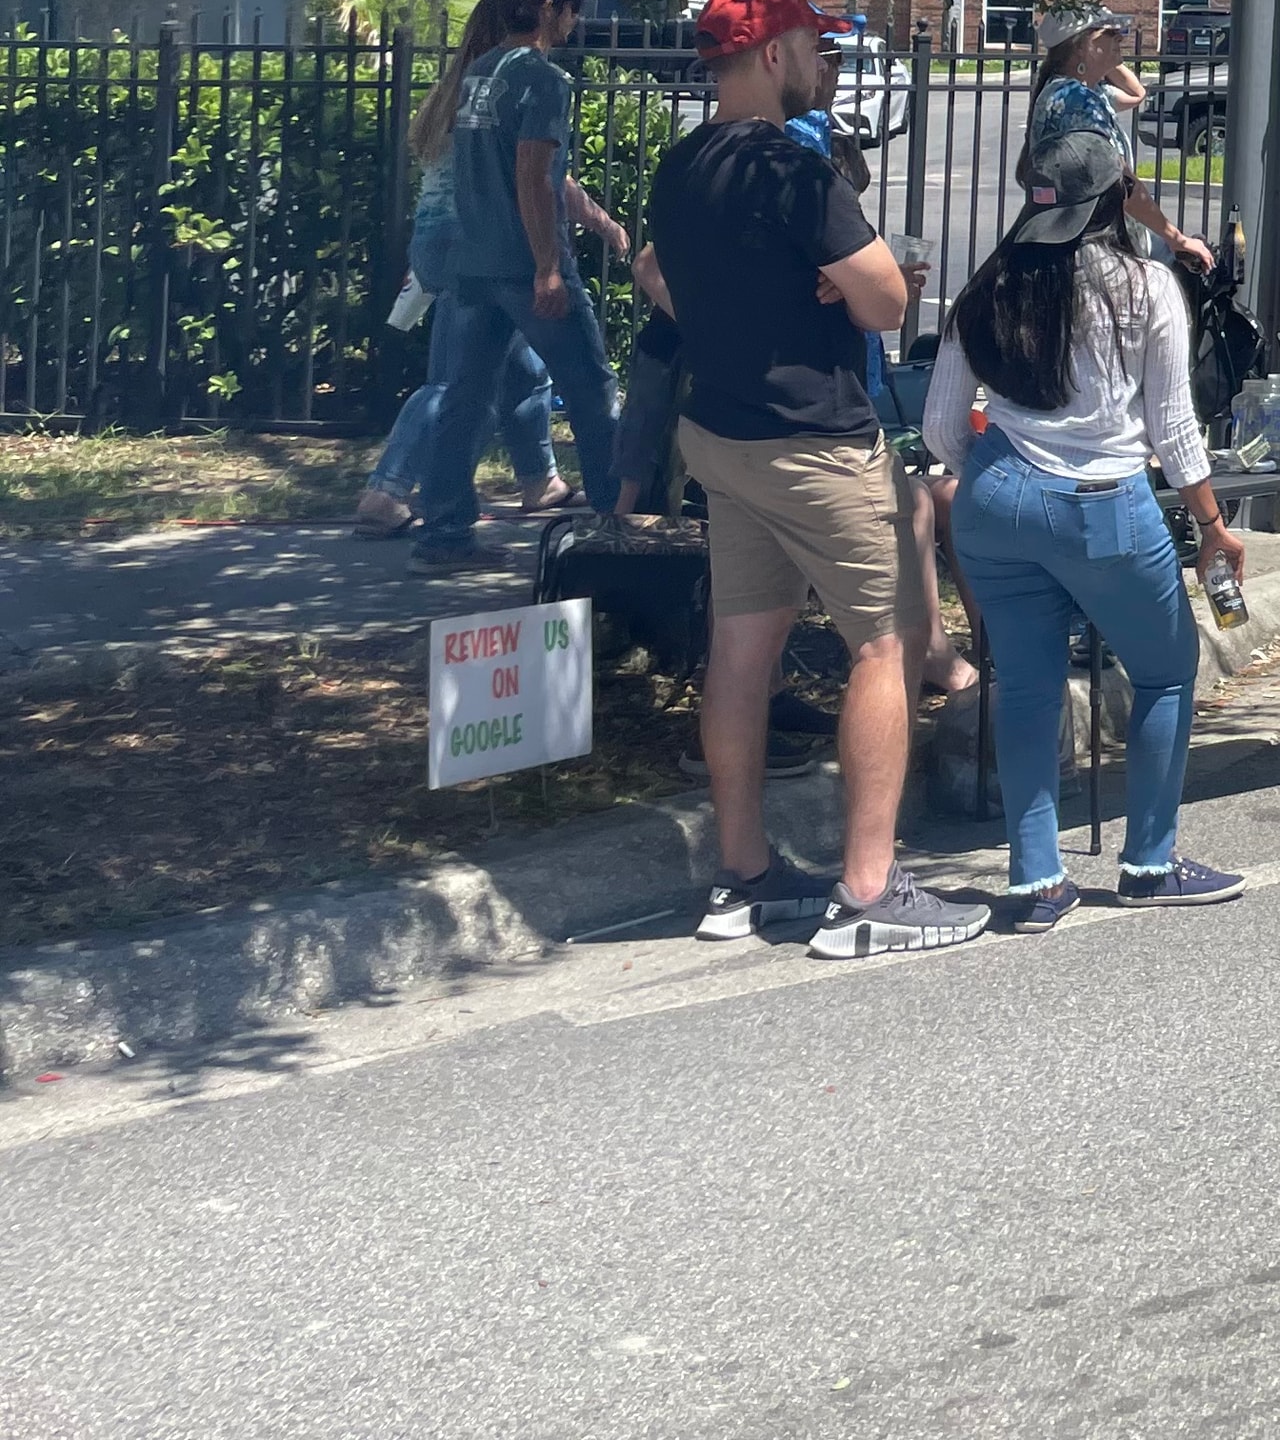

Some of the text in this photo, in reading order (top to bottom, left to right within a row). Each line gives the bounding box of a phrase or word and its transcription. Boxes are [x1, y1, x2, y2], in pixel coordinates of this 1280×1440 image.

[444, 619, 569, 665] REVIEW US
[492, 665, 519, 699] ON
[451, 713, 524, 757] GOOGLE
